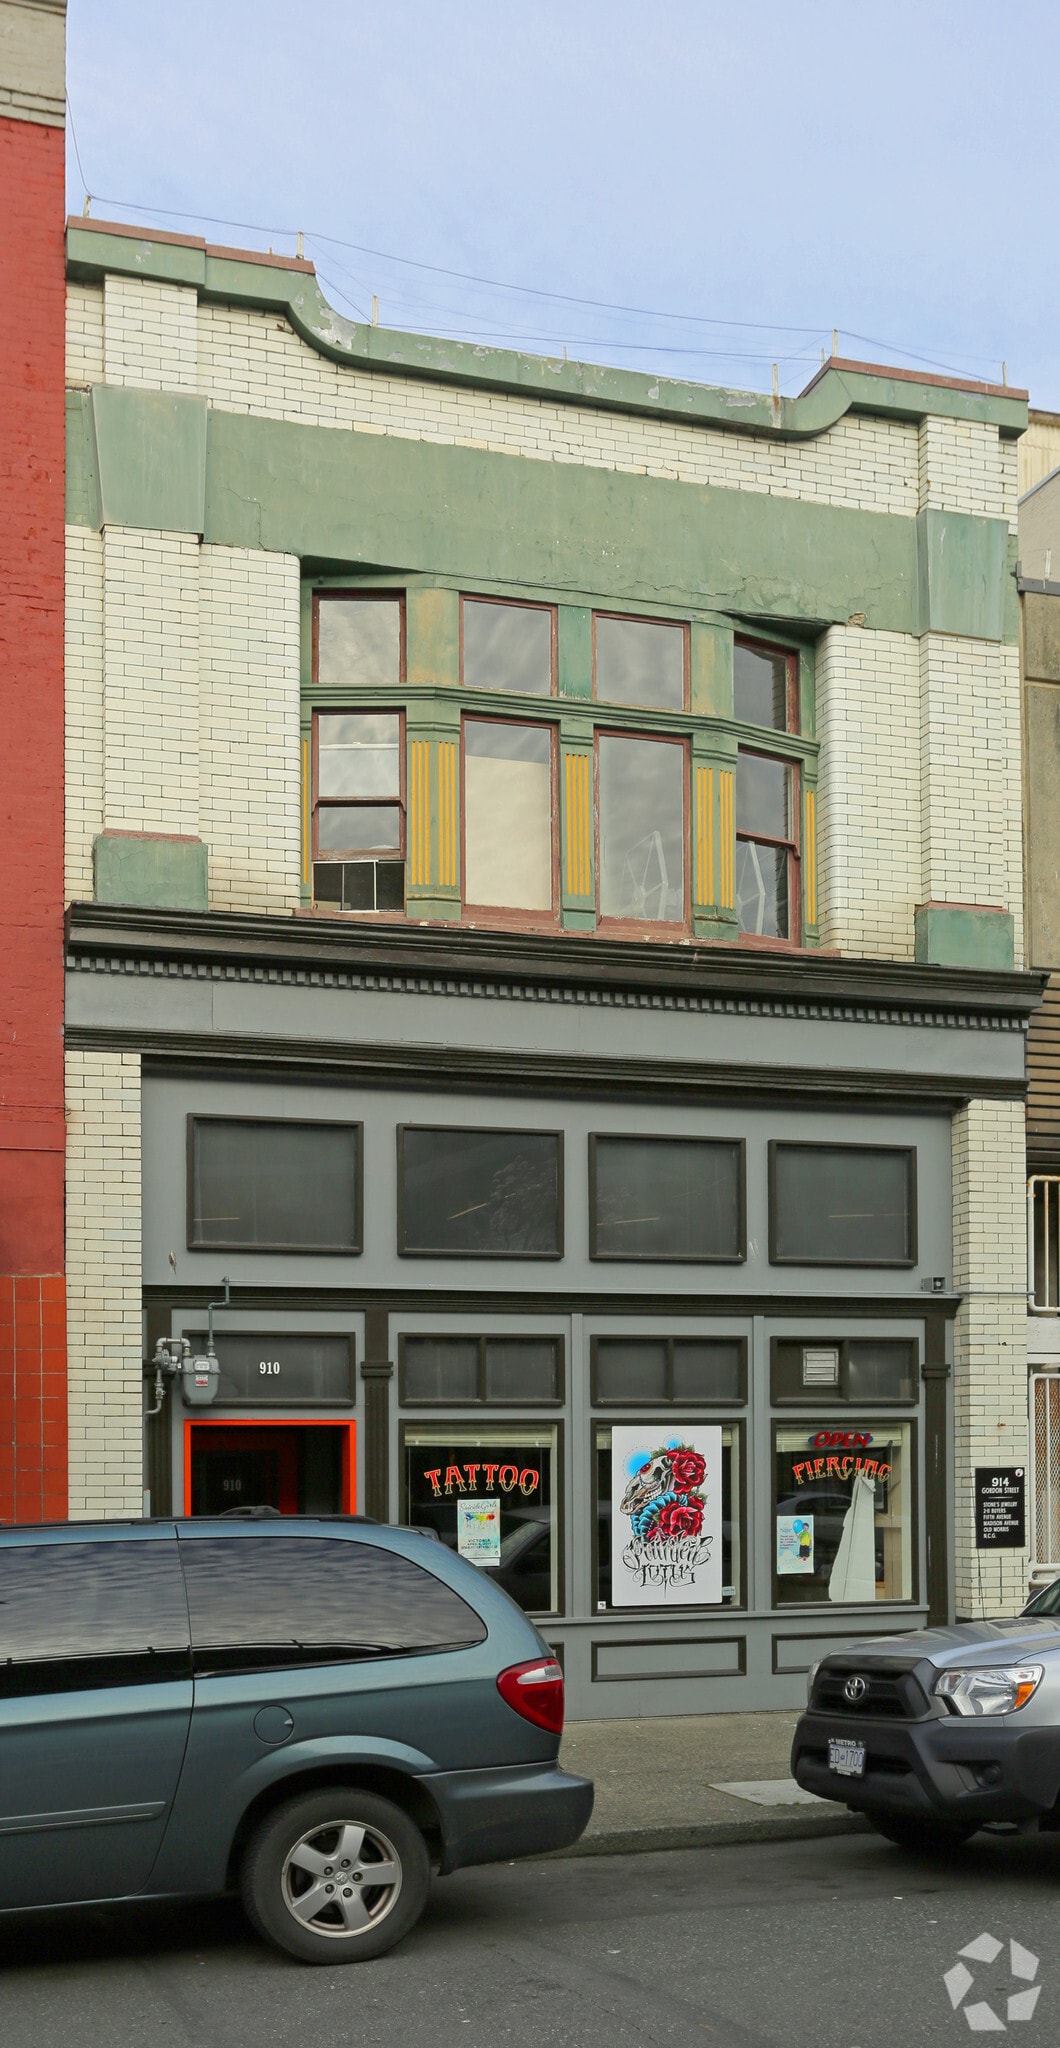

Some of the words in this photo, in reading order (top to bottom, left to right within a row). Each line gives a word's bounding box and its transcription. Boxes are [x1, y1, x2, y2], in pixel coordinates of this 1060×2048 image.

[259, 1361, 281, 1375] 910
[813, 1431, 872, 1448] OPEN
[792, 1456, 893, 1485] PIERCING
[223, 1479, 241, 1491] 910
[424, 1464, 539, 1497] TATTOO
[991, 1477, 1010, 1487] 914
